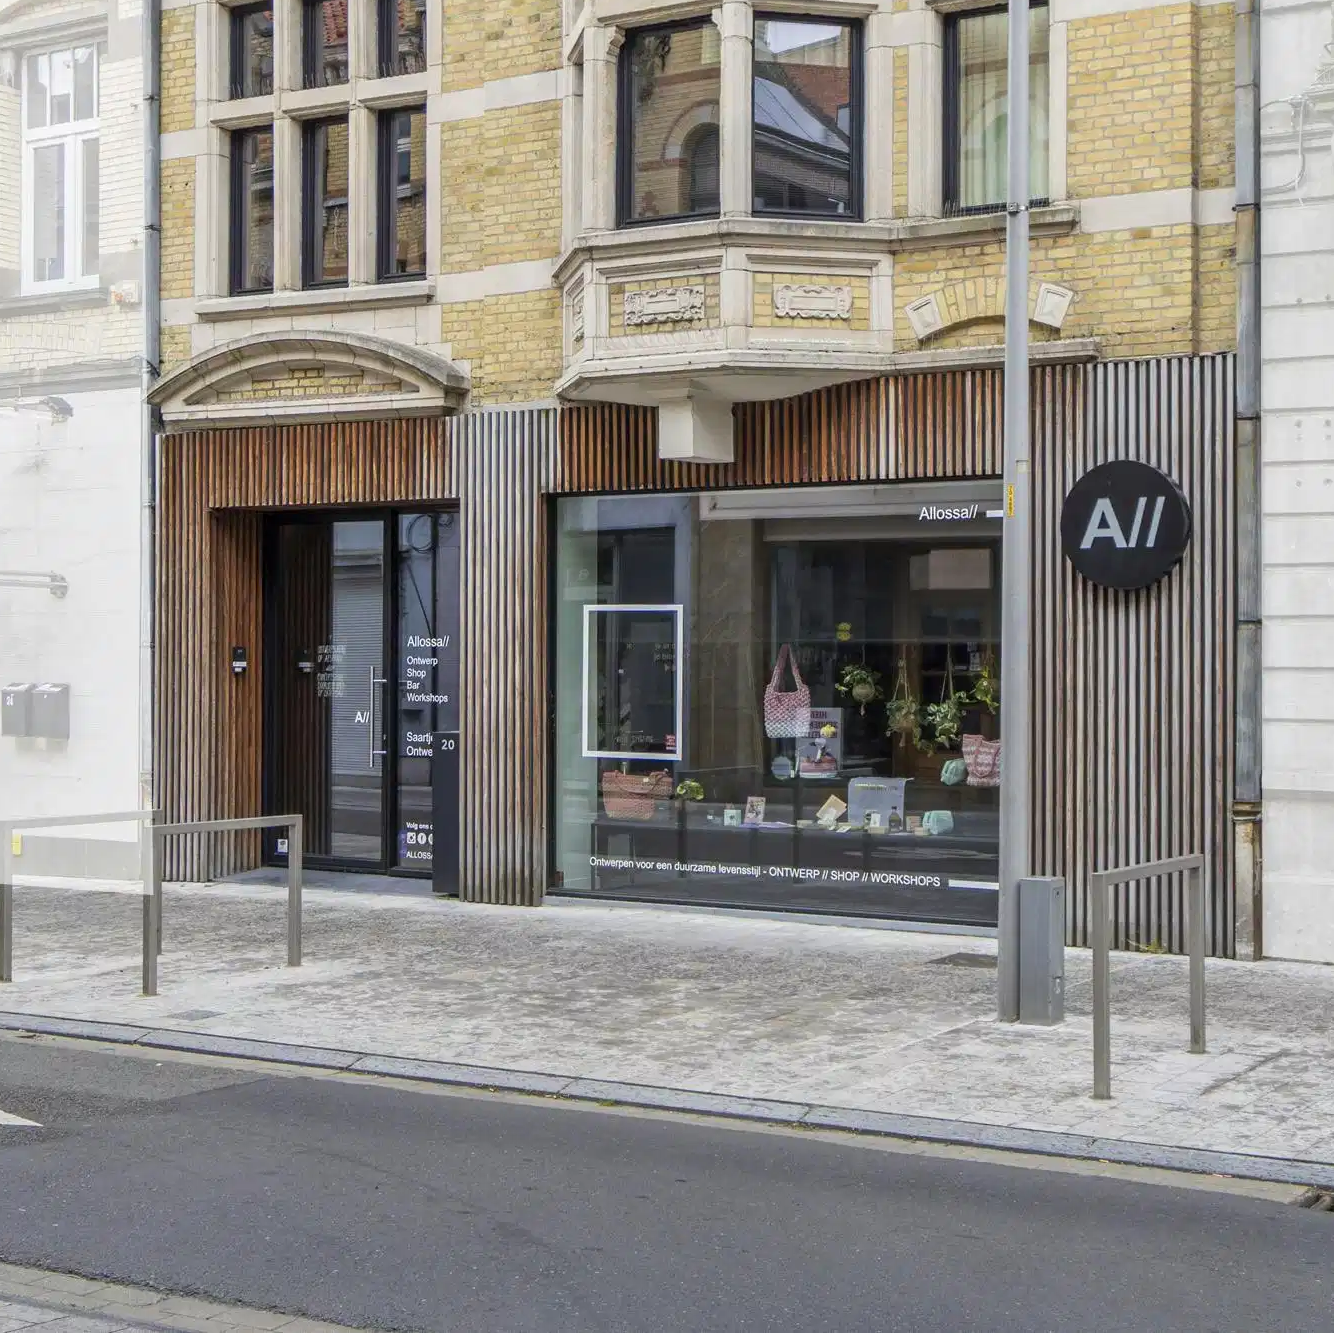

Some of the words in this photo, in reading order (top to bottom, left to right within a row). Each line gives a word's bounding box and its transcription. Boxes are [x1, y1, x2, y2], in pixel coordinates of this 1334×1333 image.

[919, 504, 979, 521] Allossa//
[407, 635, 450, 648] Allossa//
[407, 655, 438, 667] Ontwerp
[407, 668, 427, 679] Shop
[407, 680, 420, 690] Bar
[407, 692, 449, 704] Workshops
[441, 739, 455, 750] 20
[406, 822, 418, 830] Volg
[589, 856, 634, 870] Ontwerpen
[636, 860, 655, 870] voor
[656, 862, 673, 871] een
[674, 861, 716, 873] duurzame
[718, 863, 761, 878] levensstijl
[769, 866, 820, 880] ONTWERP
[830, 870, 861, 882] SHOP
[871, 872, 941, 887] WORKSHOPS
